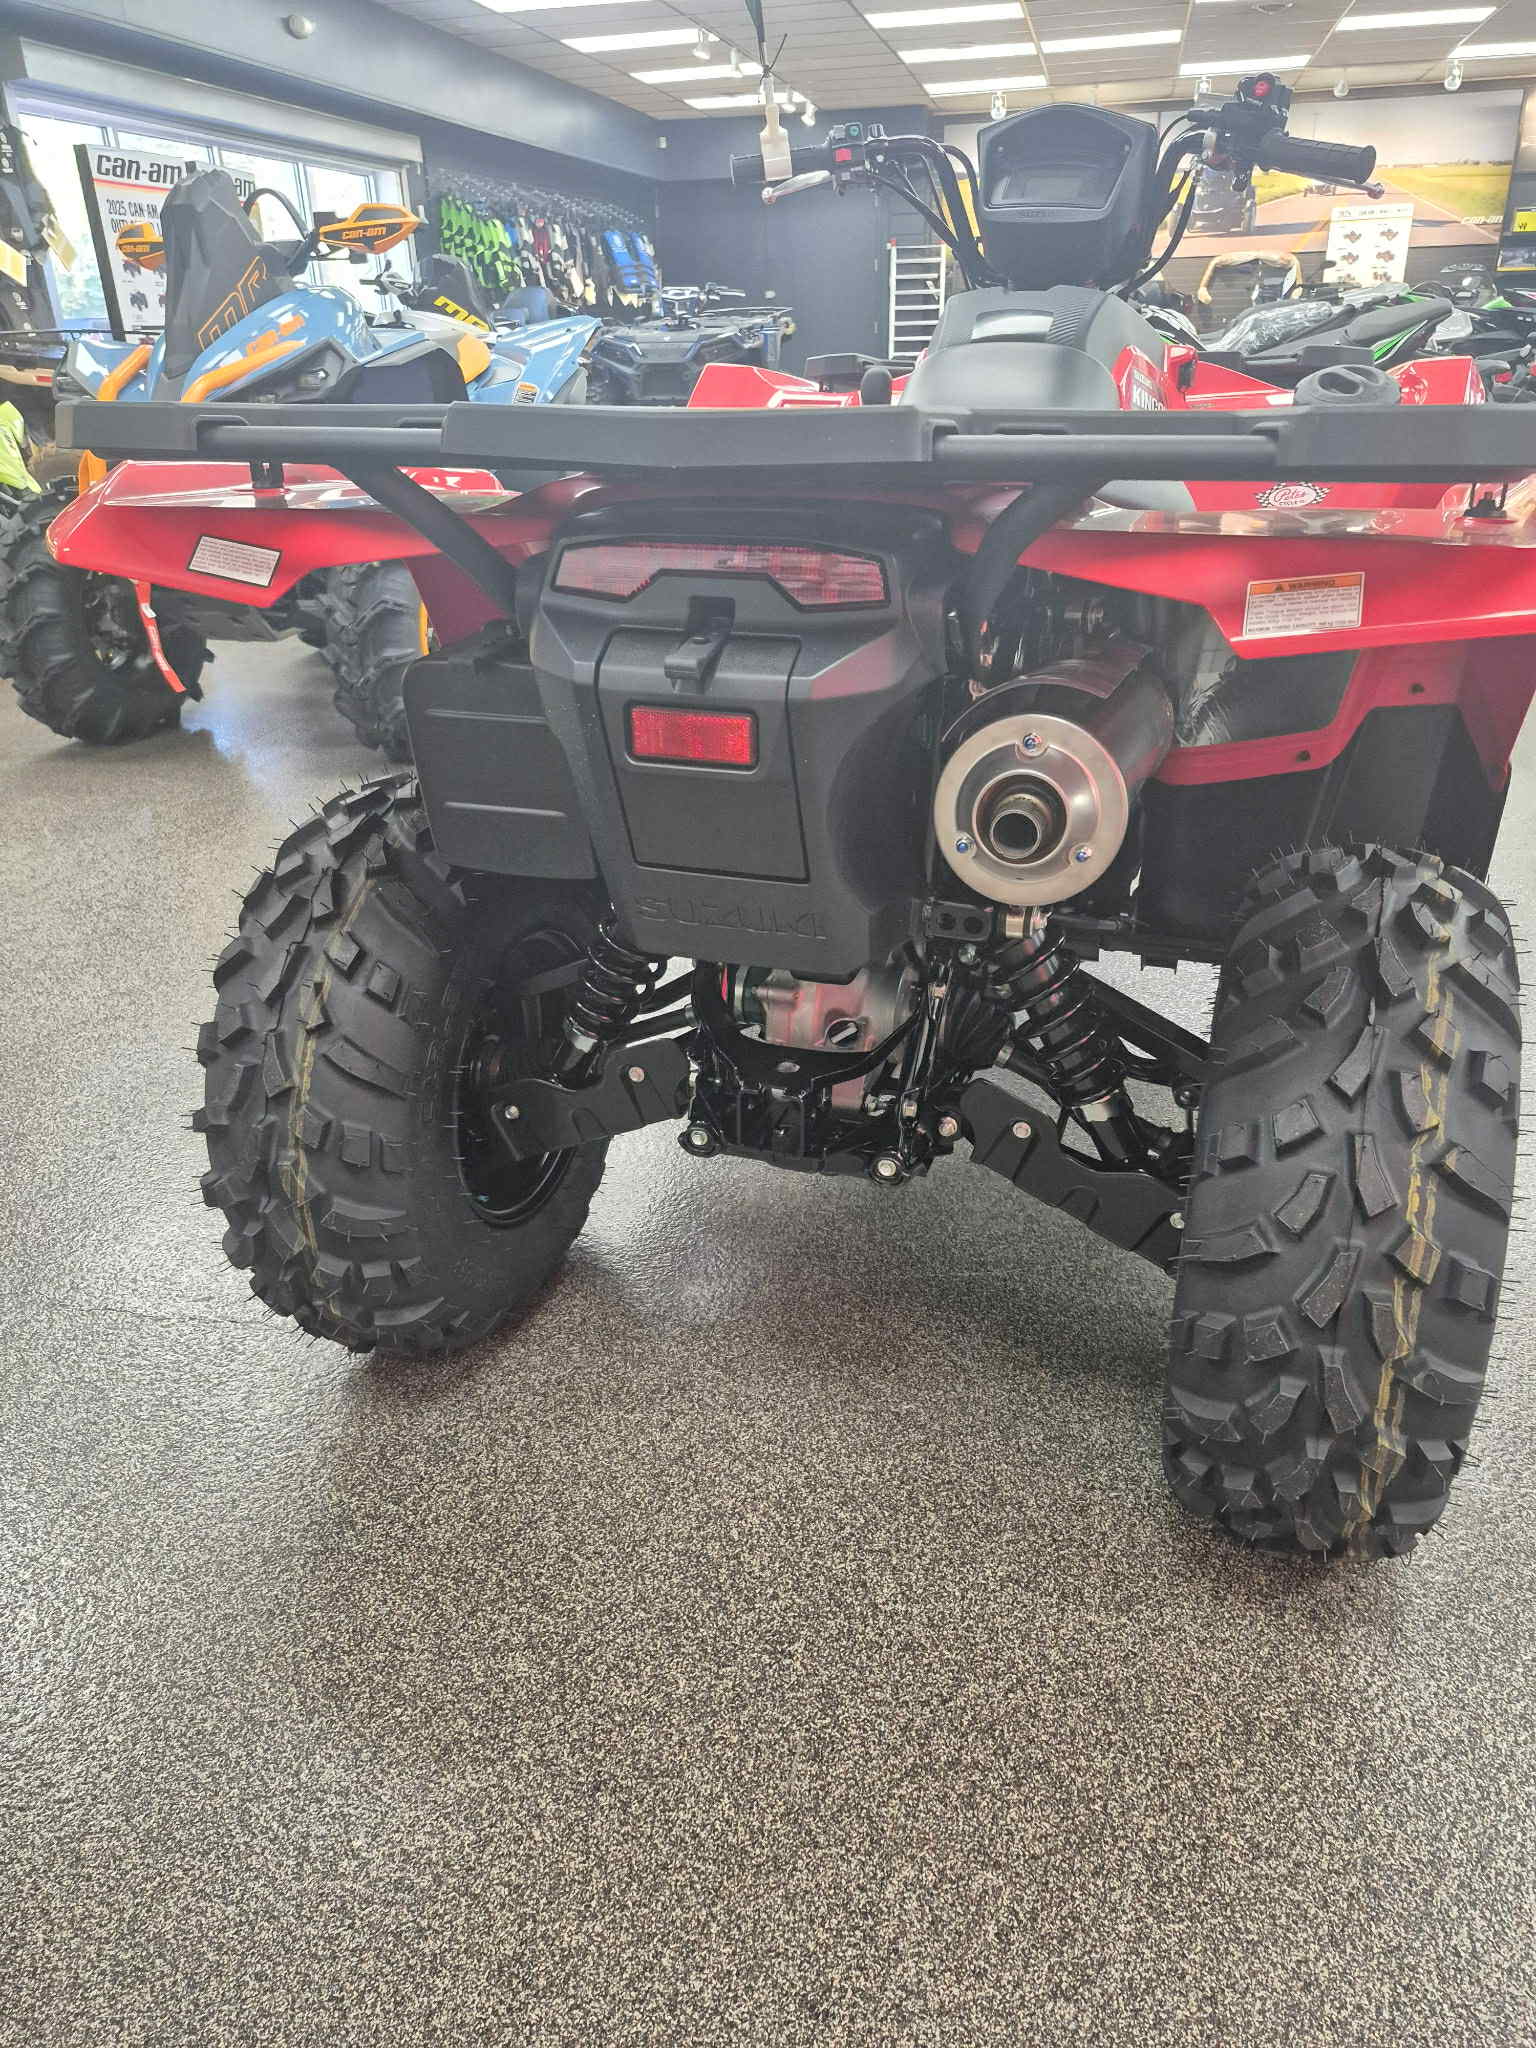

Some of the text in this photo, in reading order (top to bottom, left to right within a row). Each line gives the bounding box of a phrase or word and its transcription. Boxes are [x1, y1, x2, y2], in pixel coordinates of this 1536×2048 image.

[96, 153, 182, 186] can-am
[106, 198, 127, 216] 2025
[342, 226, 386, 240] can-am
[633, 895, 828, 941] SUZUKI
